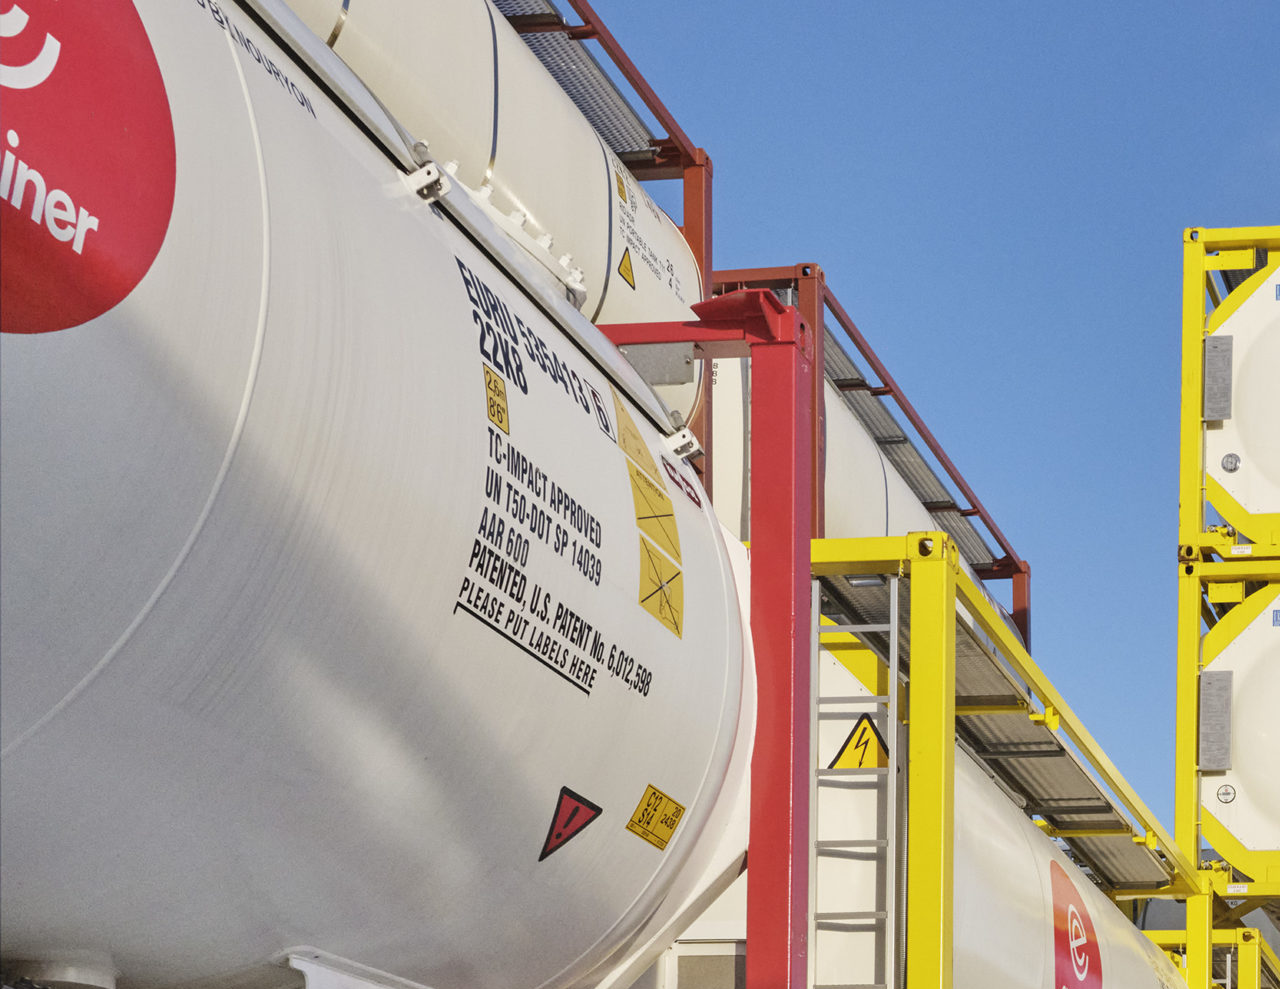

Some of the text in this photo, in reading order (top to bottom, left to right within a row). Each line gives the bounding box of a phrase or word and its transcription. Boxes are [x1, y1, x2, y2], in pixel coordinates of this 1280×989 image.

[233, 24, 316, 119] NOURYON
[455, 255, 610, 433] EURU 535413 6
[473, 309, 529, 396] 22K8
[478, 506, 530, 568] AAR 600
[485, 466, 602, 587] UN T50-DOT SP 14039
[488, 426, 602, 549] TC-IMPACT APPROVED
[458, 577, 597, 689] PLEASE PUT LABELS HERE
[468, 538, 527, 611] PATENTED,
[530, 584, 551, 625] U.S.
[553, 602, 593, 653] PATENT
[607, 644, 653, 698] 6,012,598
[638, 808, 655, 828] S14
[647, 791, 663, 812] C12
